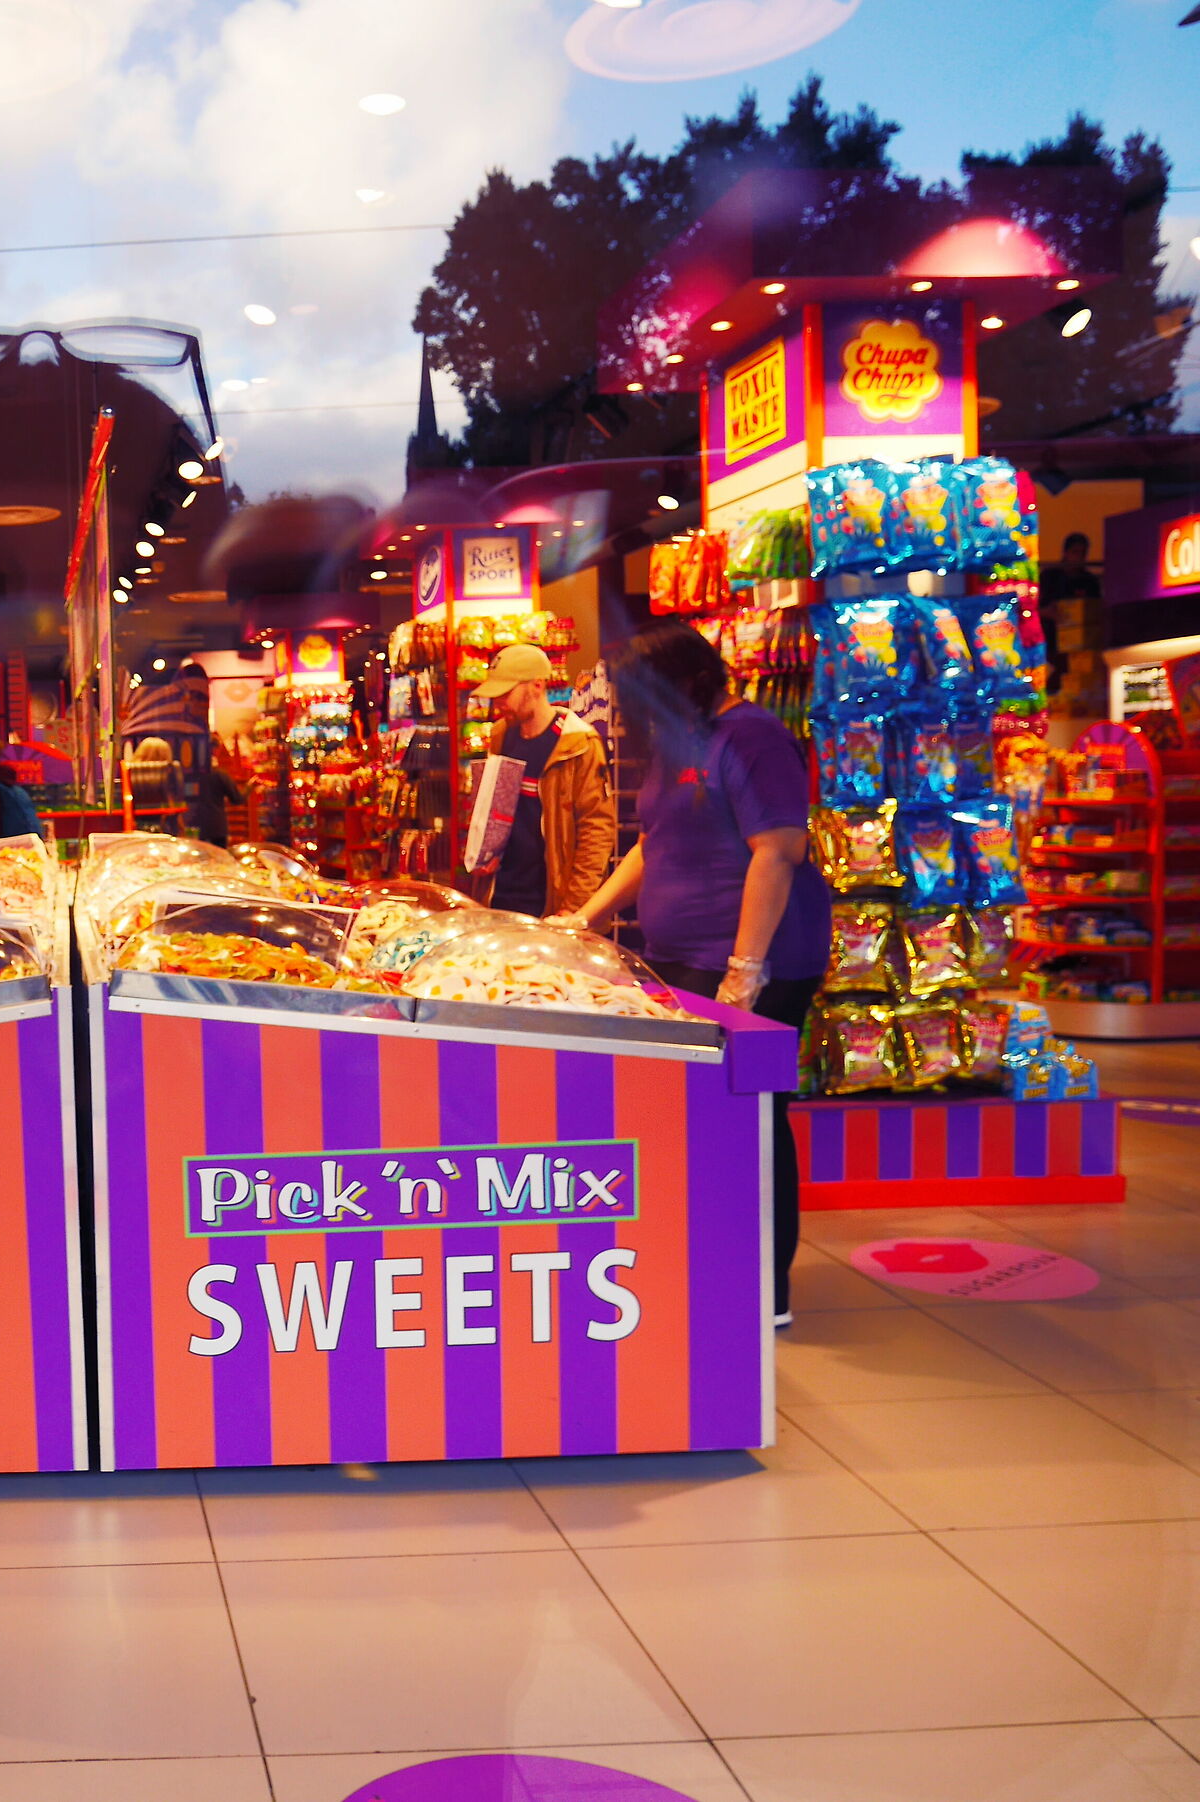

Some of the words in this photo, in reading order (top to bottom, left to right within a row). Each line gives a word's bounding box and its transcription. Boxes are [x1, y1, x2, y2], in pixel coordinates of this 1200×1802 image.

[856, 342, 929, 368] Chupa
[730, 360, 779, 410] TOXIC
[852, 366, 925, 391] Chups
[731, 394, 779, 440] WASTE
[468, 546, 515, 568] Ritter
[469, 568, 514, 581] SPORT
[196, 1160, 372, 1226] Pick
[476, 1153, 626, 1216] Mix
[187, 1248, 641, 1356] SWEETS
